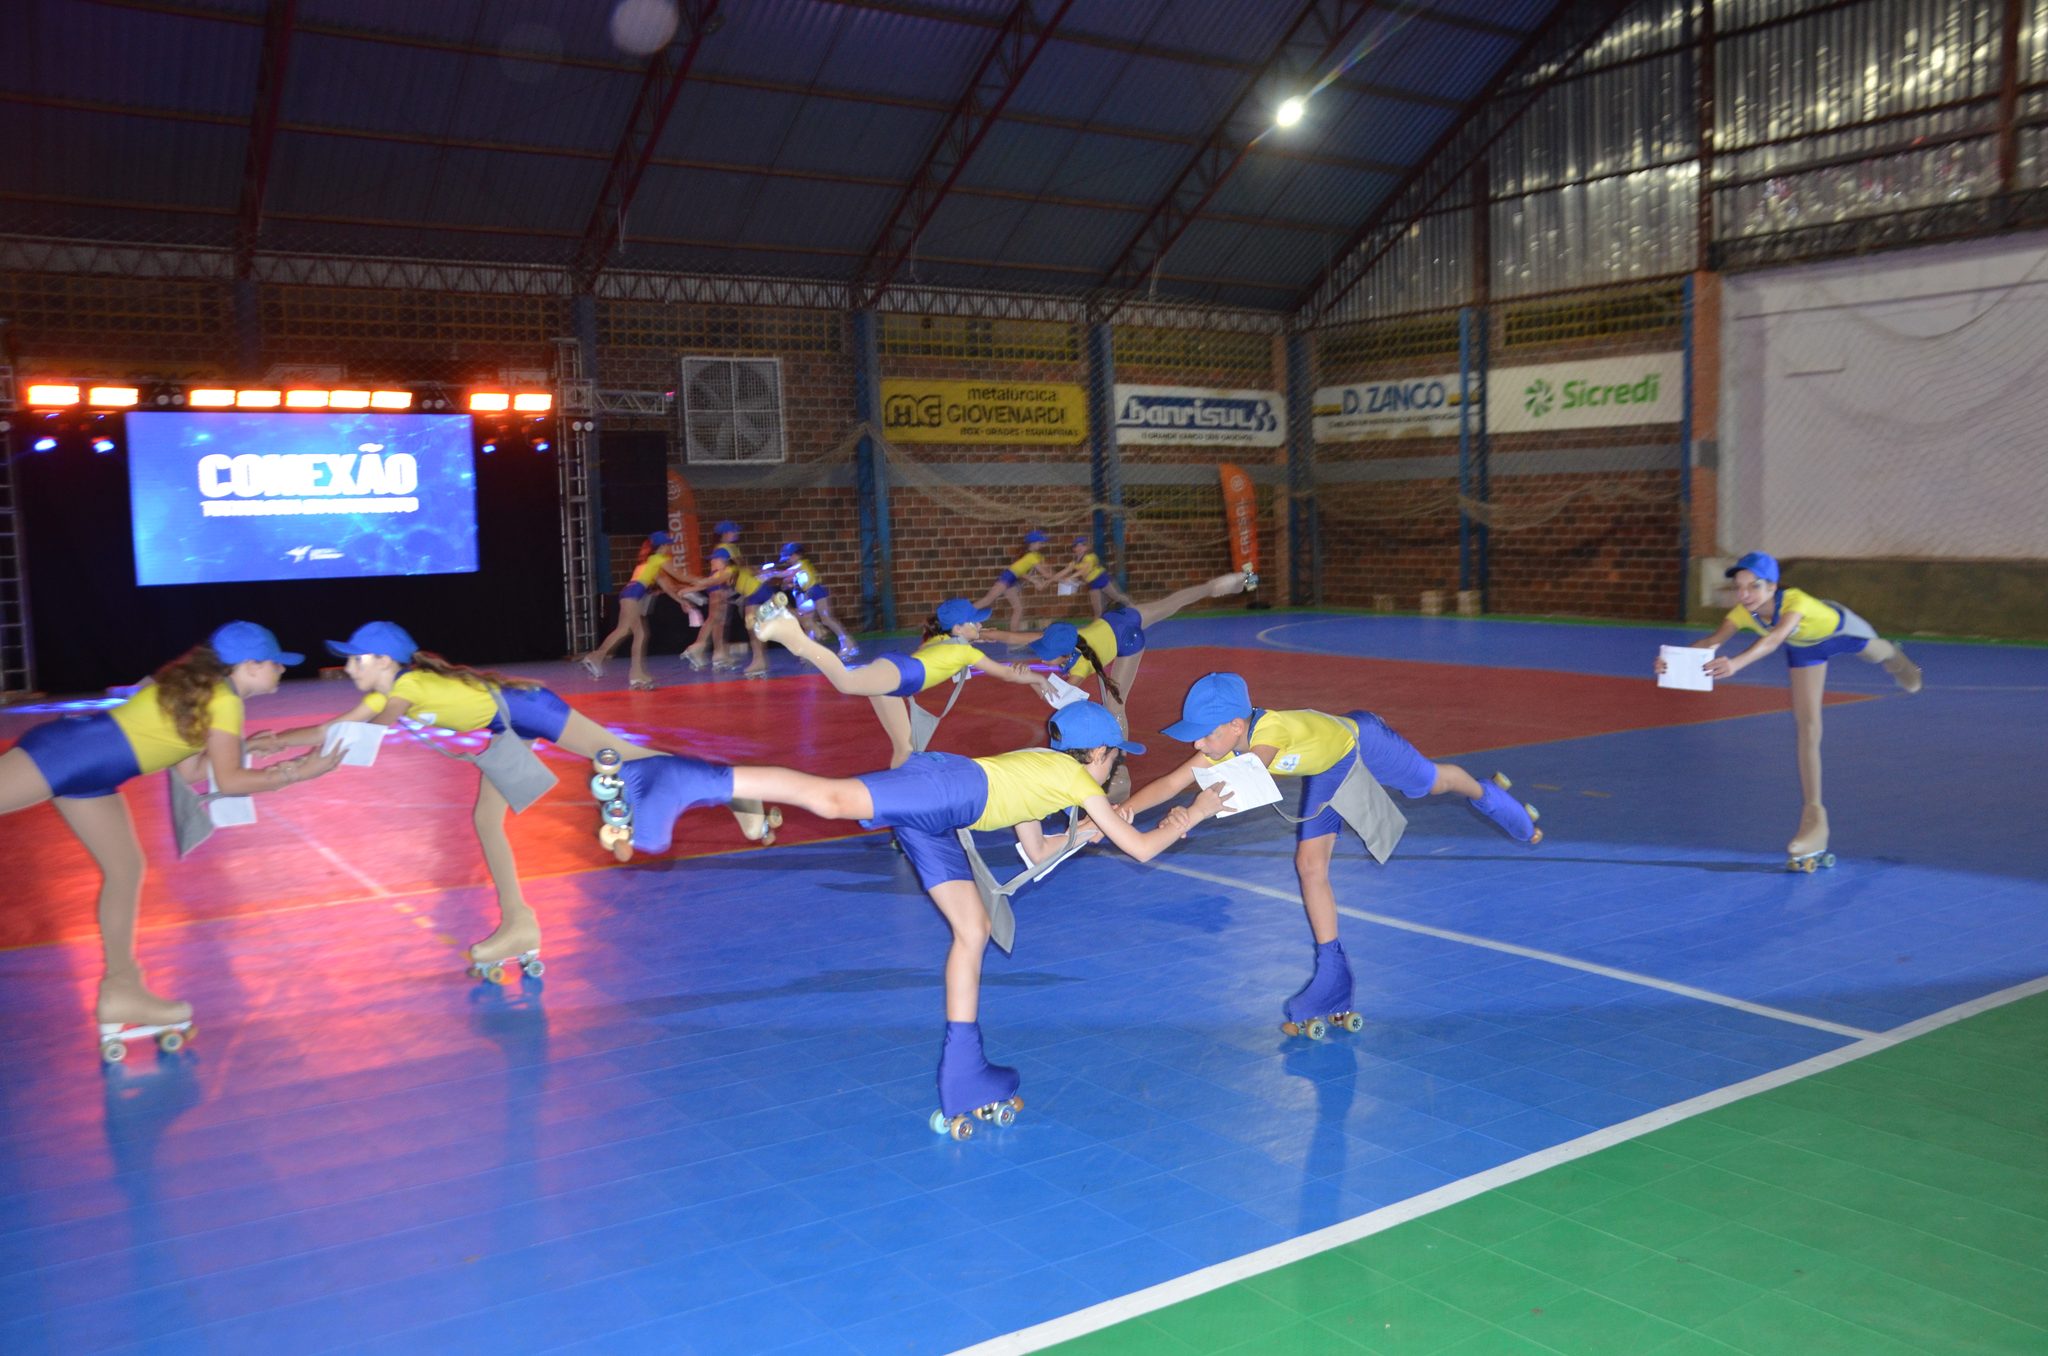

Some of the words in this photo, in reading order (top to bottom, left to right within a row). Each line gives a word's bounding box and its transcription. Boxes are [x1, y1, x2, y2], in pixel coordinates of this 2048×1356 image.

[1342, 389, 1363, 415] D.
[1366, 381, 1446, 413] ZANCO
[1561, 372, 1662, 410] Sicredi
[947, 404, 1065, 424] GIOVENARDI
[1118, 398, 1252, 428] banrisul
[198, 443, 417, 497] CONEXÃO
